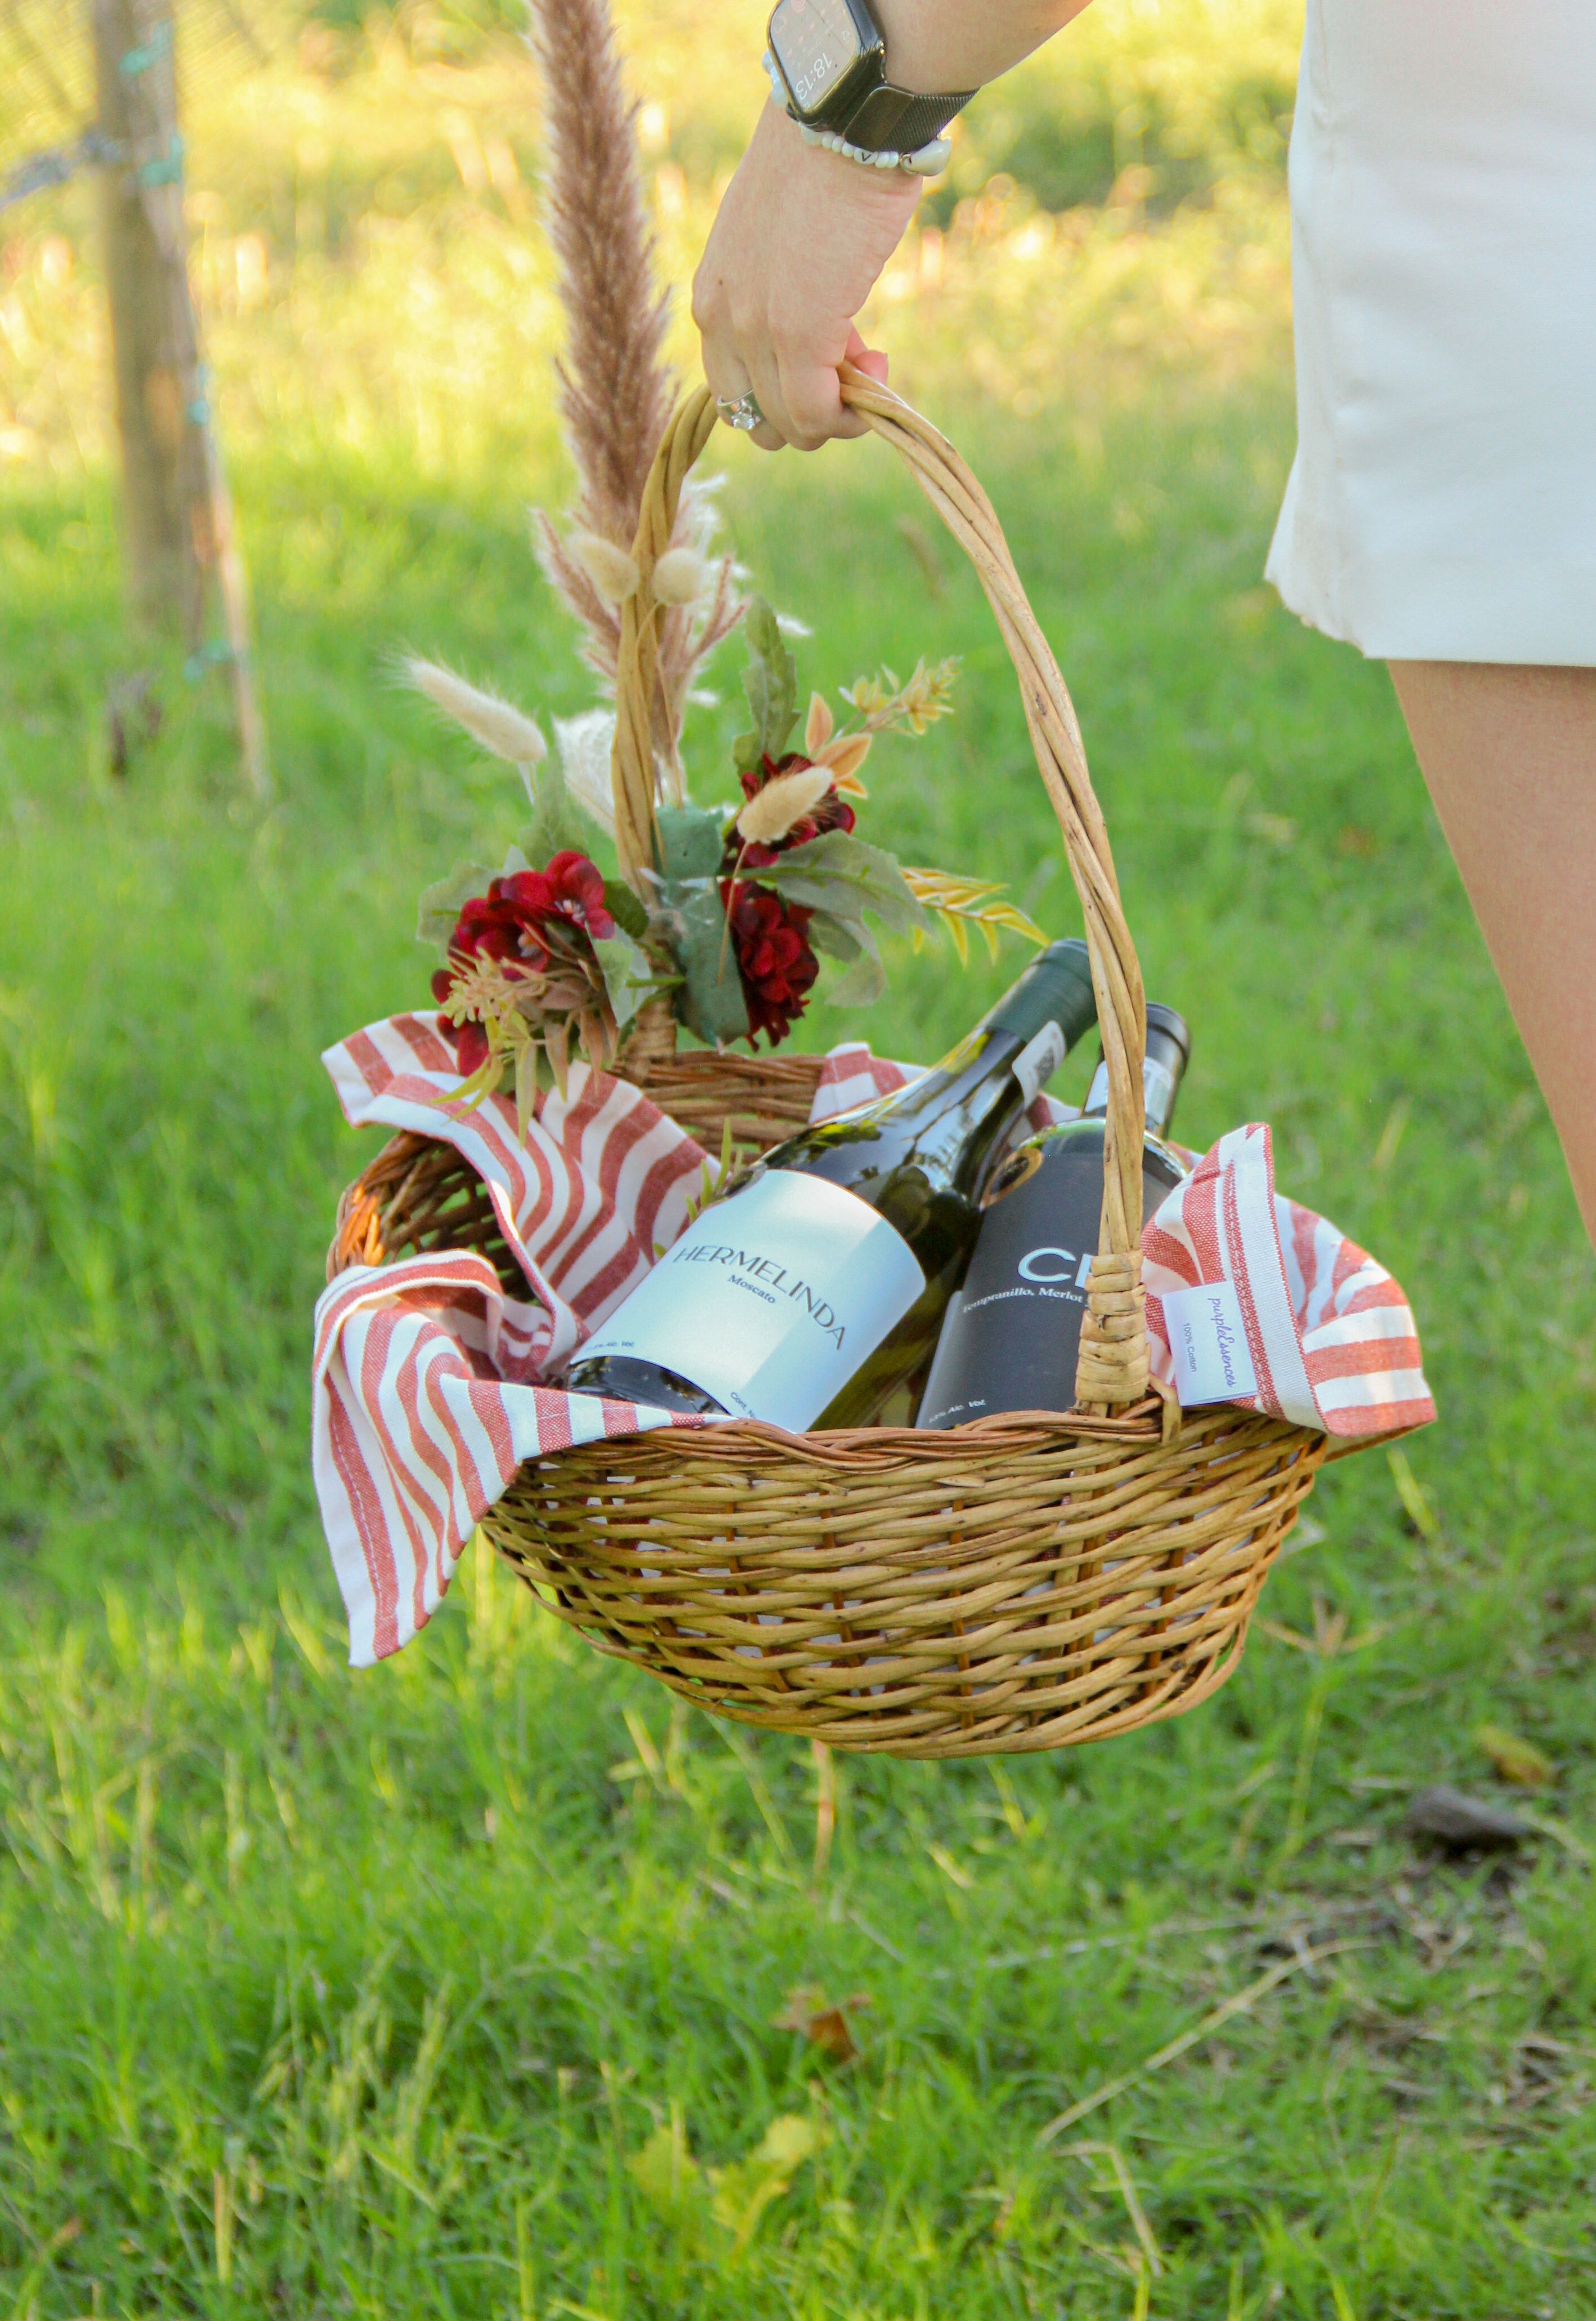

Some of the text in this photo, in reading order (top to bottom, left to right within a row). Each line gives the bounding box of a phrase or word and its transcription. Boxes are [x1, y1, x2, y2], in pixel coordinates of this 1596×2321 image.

[795, 52, 832, 100] 18:13
[673, 1244, 846, 1351] HERMELINDA
[727, 1274, 776, 1304] Moscato
[1038, 1287, 1083, 1303] Merlot
[1183, 1323, 1197, 1372] 100% Cotton
[1207, 1297, 1237, 1387] purpleEssences
